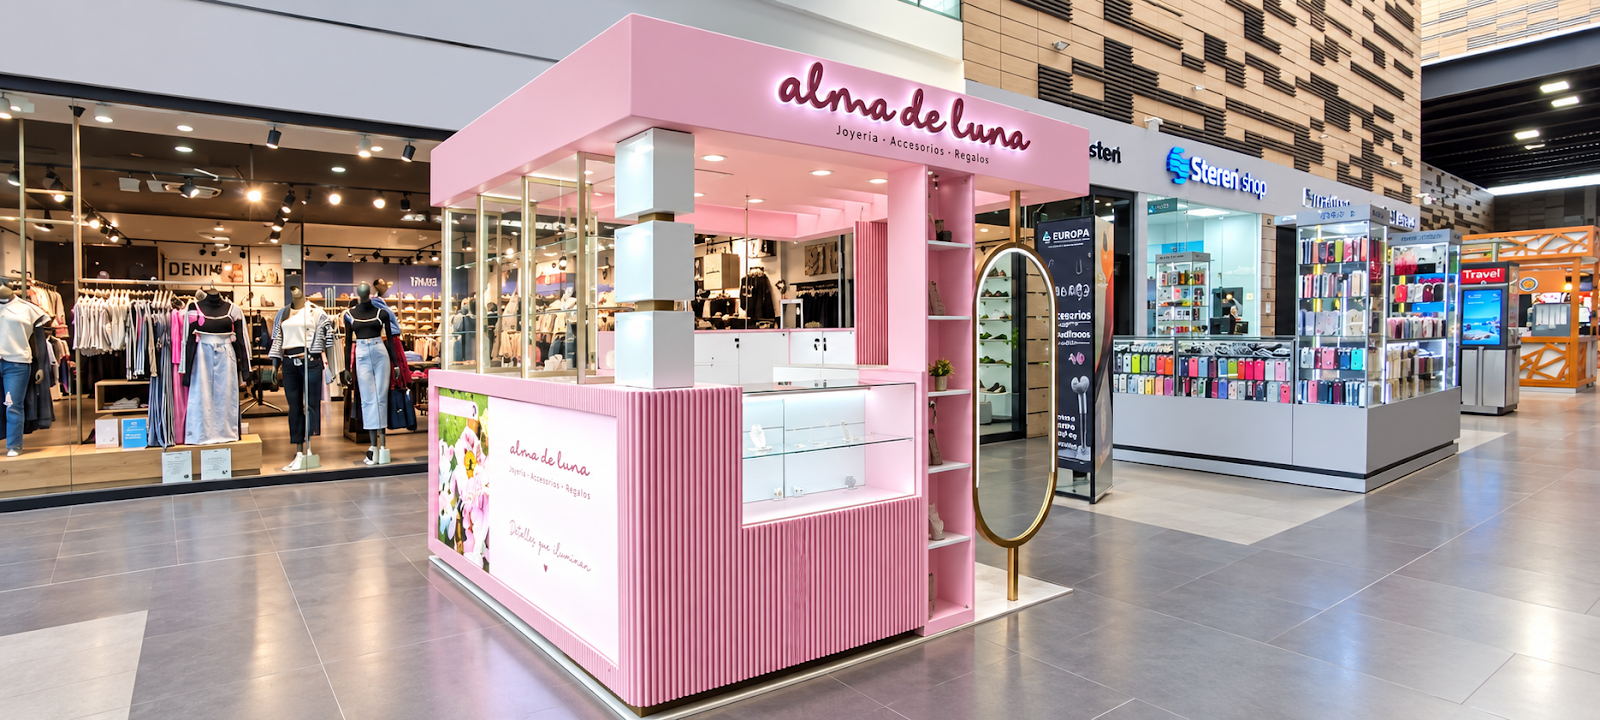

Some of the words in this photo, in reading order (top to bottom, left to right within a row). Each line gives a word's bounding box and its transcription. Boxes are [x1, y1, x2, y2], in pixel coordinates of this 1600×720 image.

[779, 62, 896, 121] alma
[900, 88, 947, 133] de
[951, 98, 1031, 151] luna
[836, 125, 878, 143] Joyería
[890, 136, 944, 156] Accesorios
[954, 149, 989, 165] Regalos
[1240, 172, 1267, 200] shop
[1053, 228, 1090, 241] EUROPA
[1462, 268, 1500, 279] Travel
[510, 440, 539, 461] alma
[541, 447, 555, 466] de
[557, 450, 590, 476] luna
[530, 472, 560, 489] Accesorios
[565, 483, 591, 500] Regalos
[537, 540, 550, 555] que
